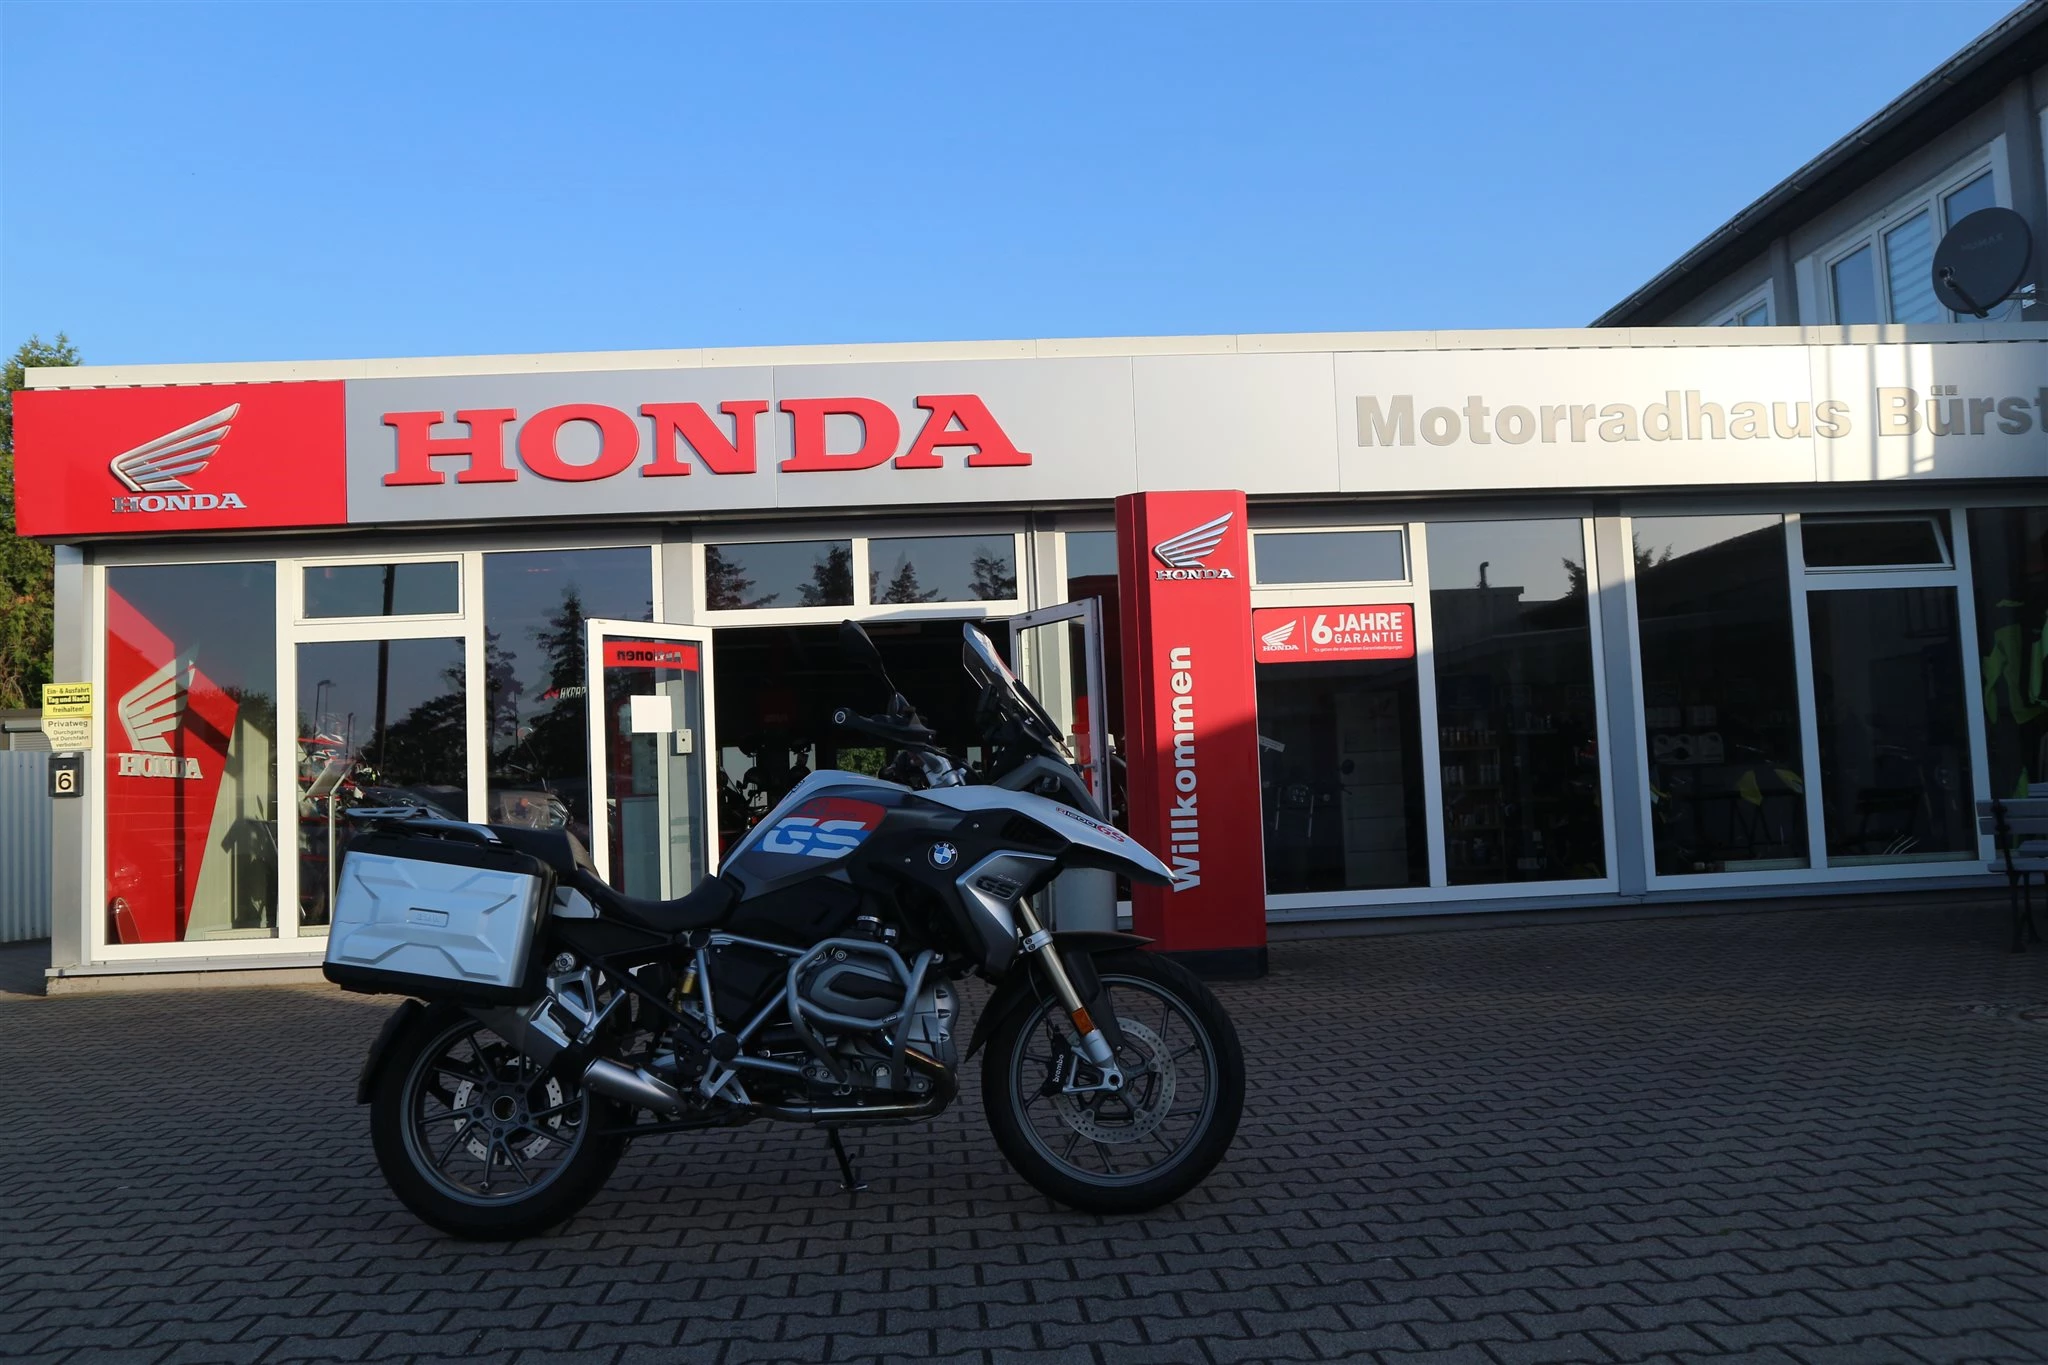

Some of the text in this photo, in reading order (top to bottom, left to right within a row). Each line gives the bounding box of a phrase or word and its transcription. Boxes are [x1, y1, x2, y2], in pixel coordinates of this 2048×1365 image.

[1355, 390, 1852, 447] Motorradhaus
[382, 394, 1032, 486] HONDA
[112, 493, 247, 512] HONDA
[1155, 569, 1234, 581] HONDA
[1311, 614, 1333, 645] 6
[1334, 632, 1403, 644] GARANTIE
[1263, 644, 1299, 652] HONDA
[48, 696, 60, 705] Tag
[72, 695, 89, 703] Nacht
[48, 720, 88, 728] Privatweg
[118, 752, 204, 779] HONDA
[1169, 645, 1201, 893] Willkommen
[57, 772, 72, 791] 6
[762, 816, 867, 859] GS
[1052, 1054, 1064, 1083] brembo
